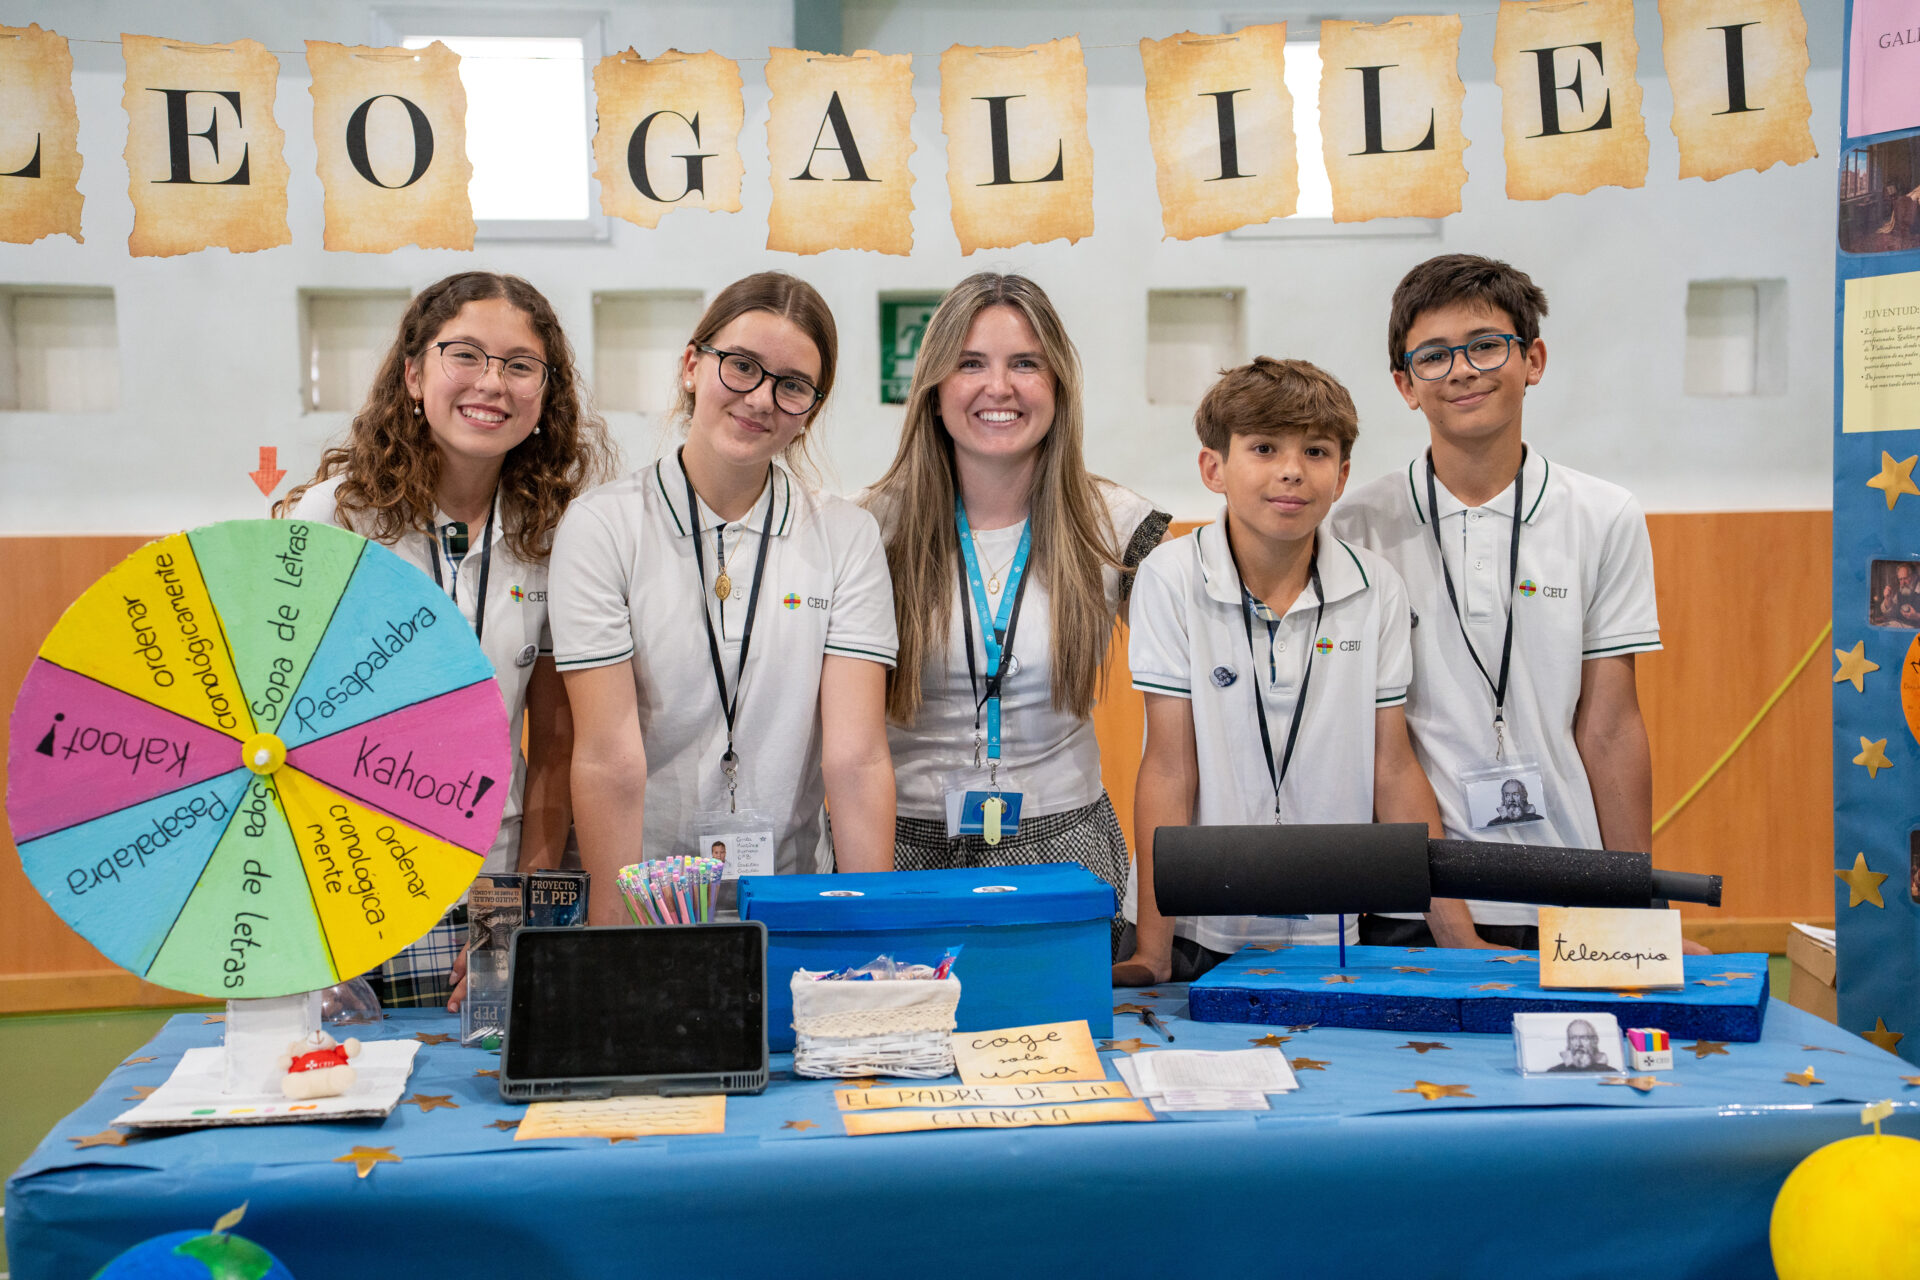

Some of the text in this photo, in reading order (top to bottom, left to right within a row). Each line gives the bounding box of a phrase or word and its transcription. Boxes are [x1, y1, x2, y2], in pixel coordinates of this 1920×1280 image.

[627, 21, 1766, 203] GALILEI
[807, 597, 828, 611] CEU
[1543, 586, 1567, 599] CEU
[123, 595, 174, 687] ordenar
[155, 553, 237, 730] cronológicamente
[267, 604, 300, 642] de
[1340, 640, 1361, 652] CEU
[251, 657, 293, 721] Sopa
[294, 606, 437, 734] Pasapalabra
[35, 712, 190, 778] Kahoot!
[353, 736, 495, 819] Kahoot!
[66, 790, 229, 895] Pasapalabra
[306, 823, 344, 894] mente
[223, 782, 276, 989] Sopa de letras
[531, 880, 578, 891] PROYECTO:
[532, 890, 578, 906] EL PEP
[1552, 933, 1671, 969] telescopio
[972, 1031, 1062, 1053] coge
[980, 1065, 1078, 1080] una
[846, 1083, 1111, 1107] EL PADRE DE LA
[932, 1107, 1071, 1126] CIENCIA
